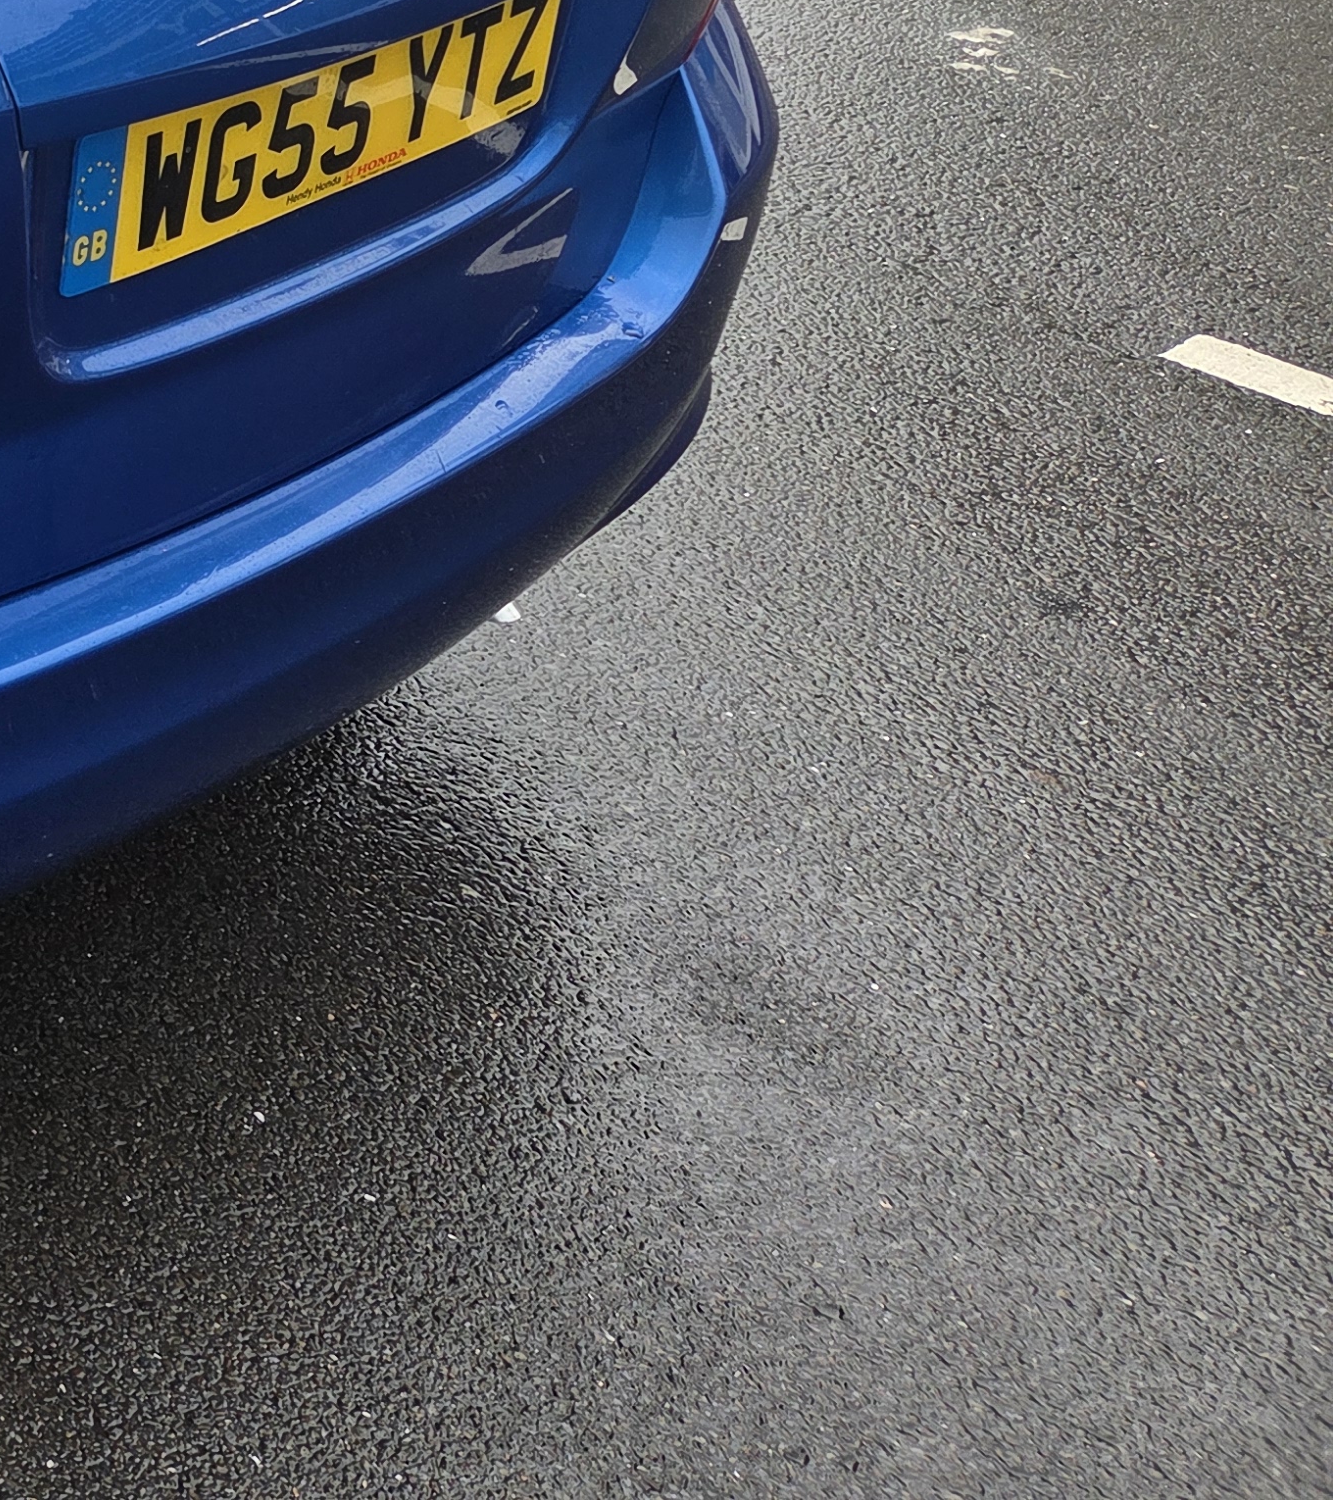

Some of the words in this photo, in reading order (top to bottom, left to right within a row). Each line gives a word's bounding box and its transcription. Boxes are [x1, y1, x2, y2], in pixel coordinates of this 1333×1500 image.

[137, 52, 379, 252] WG55
[356, 148, 408, 178] HONDA
[72, 230, 107, 266] GB
